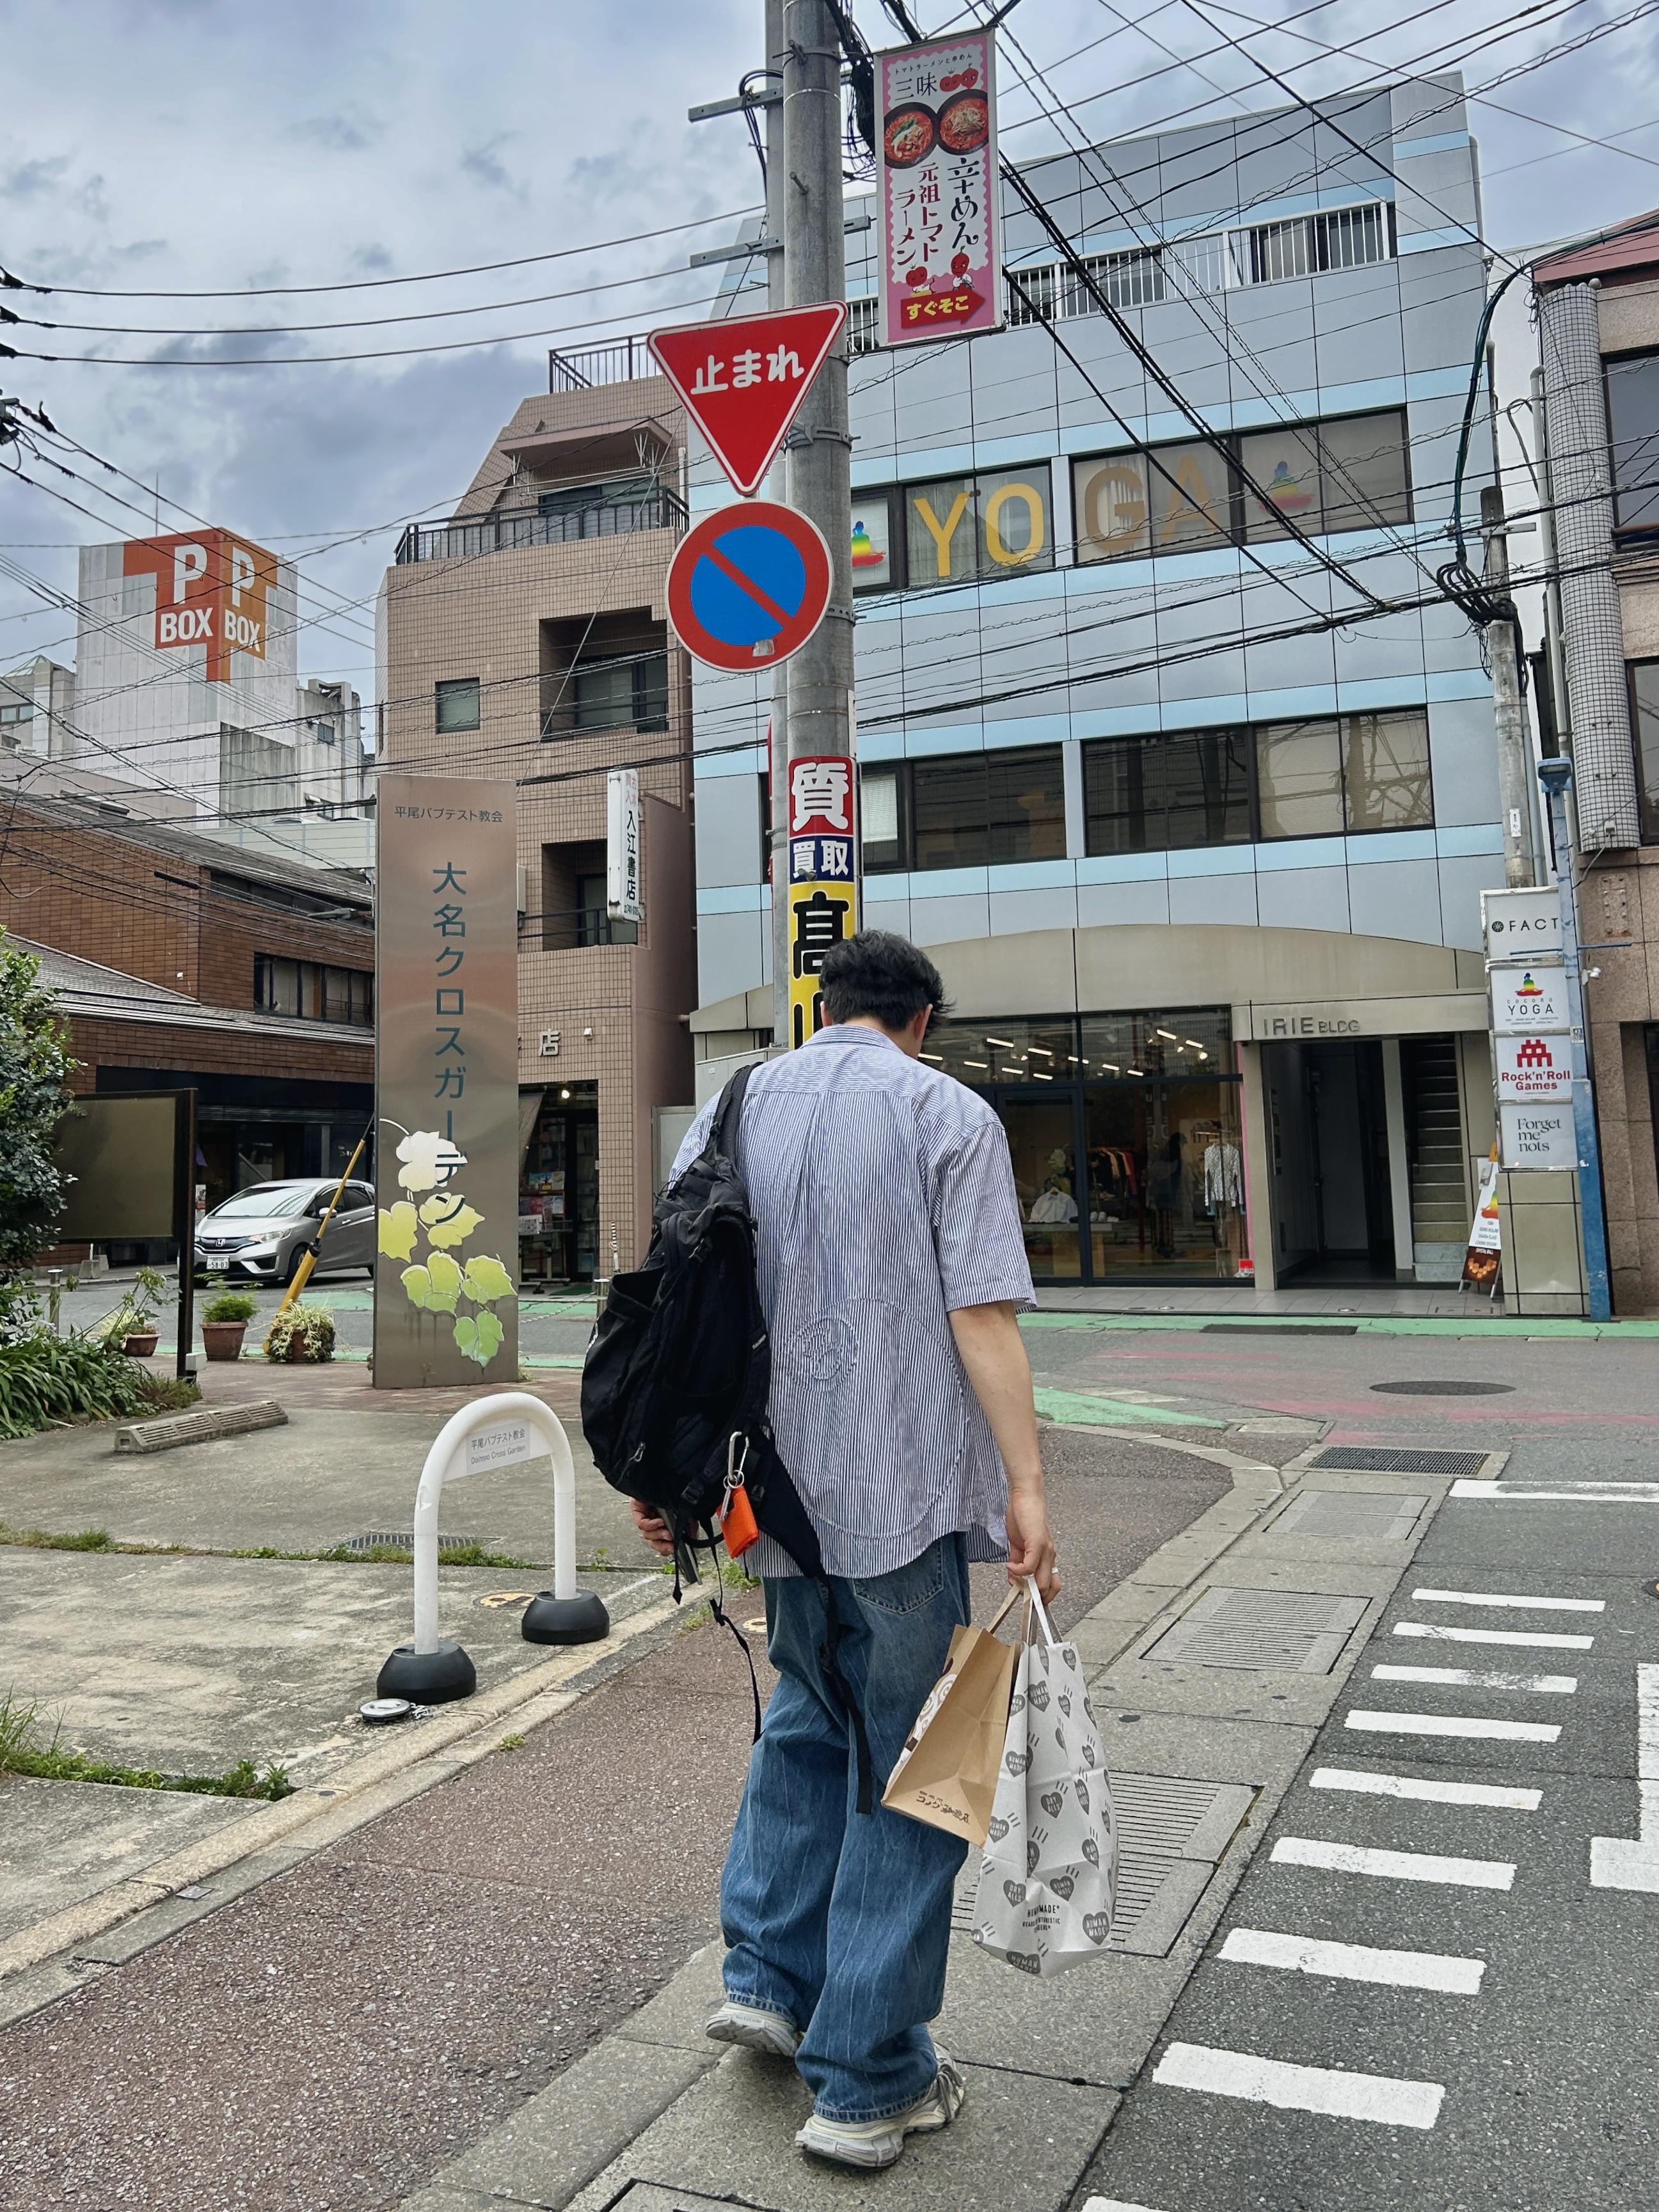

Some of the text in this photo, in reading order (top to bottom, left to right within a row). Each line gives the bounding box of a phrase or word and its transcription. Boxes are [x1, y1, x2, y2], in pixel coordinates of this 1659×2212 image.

[894, 71, 938, 101] 三味
[917, 162, 943, 262] 元祖トマト
[948, 157, 980, 249] 辛めん
[894, 189, 916, 266] ラーメン
[907, 295, 969, 320] すぐそこ
[690, 344, 805, 395] 止まれ
[914, 454, 1219, 578] YOGA
[173, 544, 208, 605] P
[232, 546, 255, 608] P
[160, 607, 214, 644] BOX
[225, 608, 260, 652] BOX
[791, 761, 850, 832] 質
[394, 805, 503, 823] 平尾バプテスト教会
[626, 810, 637, 901] 入江書店
[793, 840, 848, 878] 買取
[1509, 917, 1559, 932] FACT
[1507, 1004, 1553, 1015] YOGA
[1263, 1016, 1360, 1036] IRIE BLDG
[433, 862, 467, 1224] 大名クロスガーデン
[1501, 1070, 1571, 1082] Rock'n'Roll
[1516, 1081, 1558, 1091] Games
[1517, 1118, 1561, 1134] Forget
[1518, 1132, 1541, 1141] me
[1519, 1141, 1550, 1152] nots
[471, 1428, 526, 1450] 平尾バプテスト教会
[471, 1445, 526, 1465] Daimyo Cross Garden
[1046, 1796, 1057, 1805] DRY
[1007, 1892, 1022, 1902] ALLS
[1009, 1884, 1022, 1894] DRY
[1089, 1927, 1106, 1937] MADE
